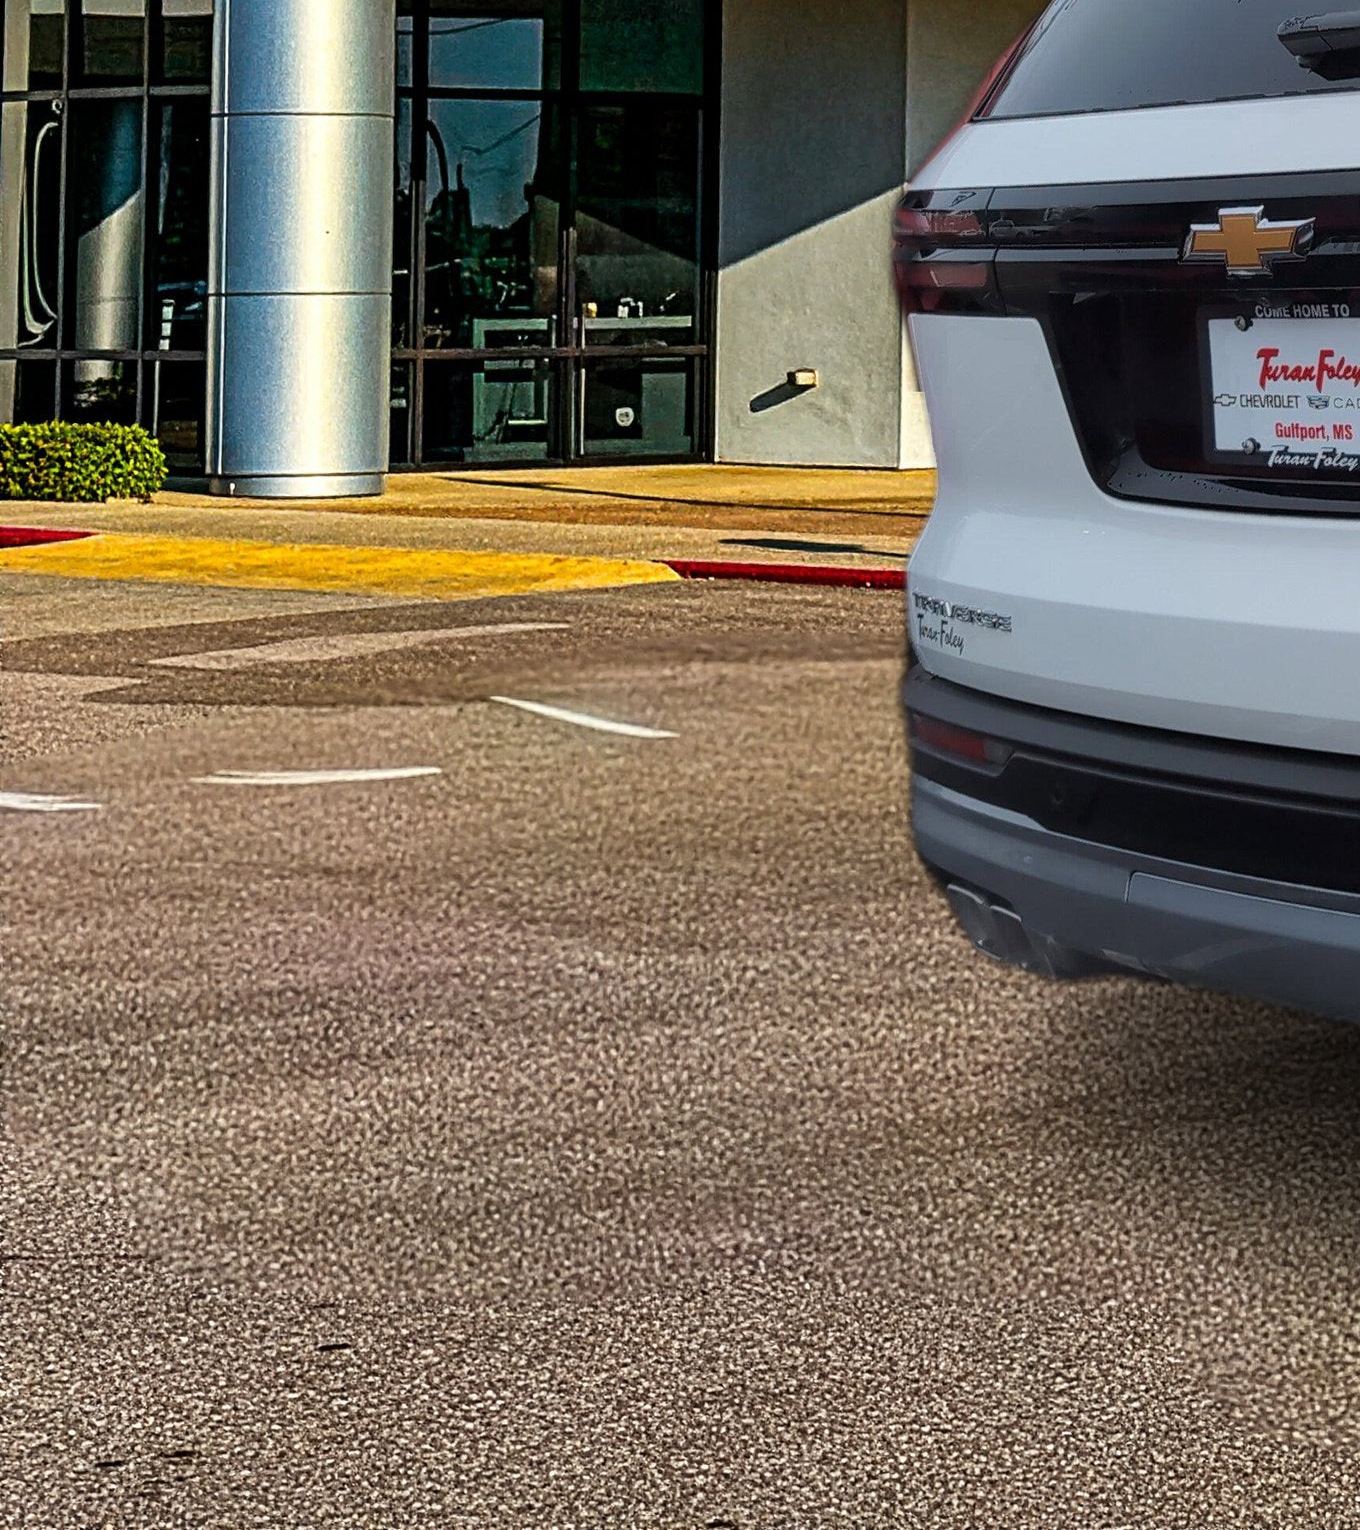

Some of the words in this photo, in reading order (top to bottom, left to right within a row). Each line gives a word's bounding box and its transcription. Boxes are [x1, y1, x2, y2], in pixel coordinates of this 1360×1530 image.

[1292, 303, 1330, 318] HOME
[1331, 303, 1350, 318] TO
[1239, 394, 1300, 409] CHEVROLET
[1275, 422, 1330, 442] Gulfport,
[1332, 423, 1353, 440] MS
